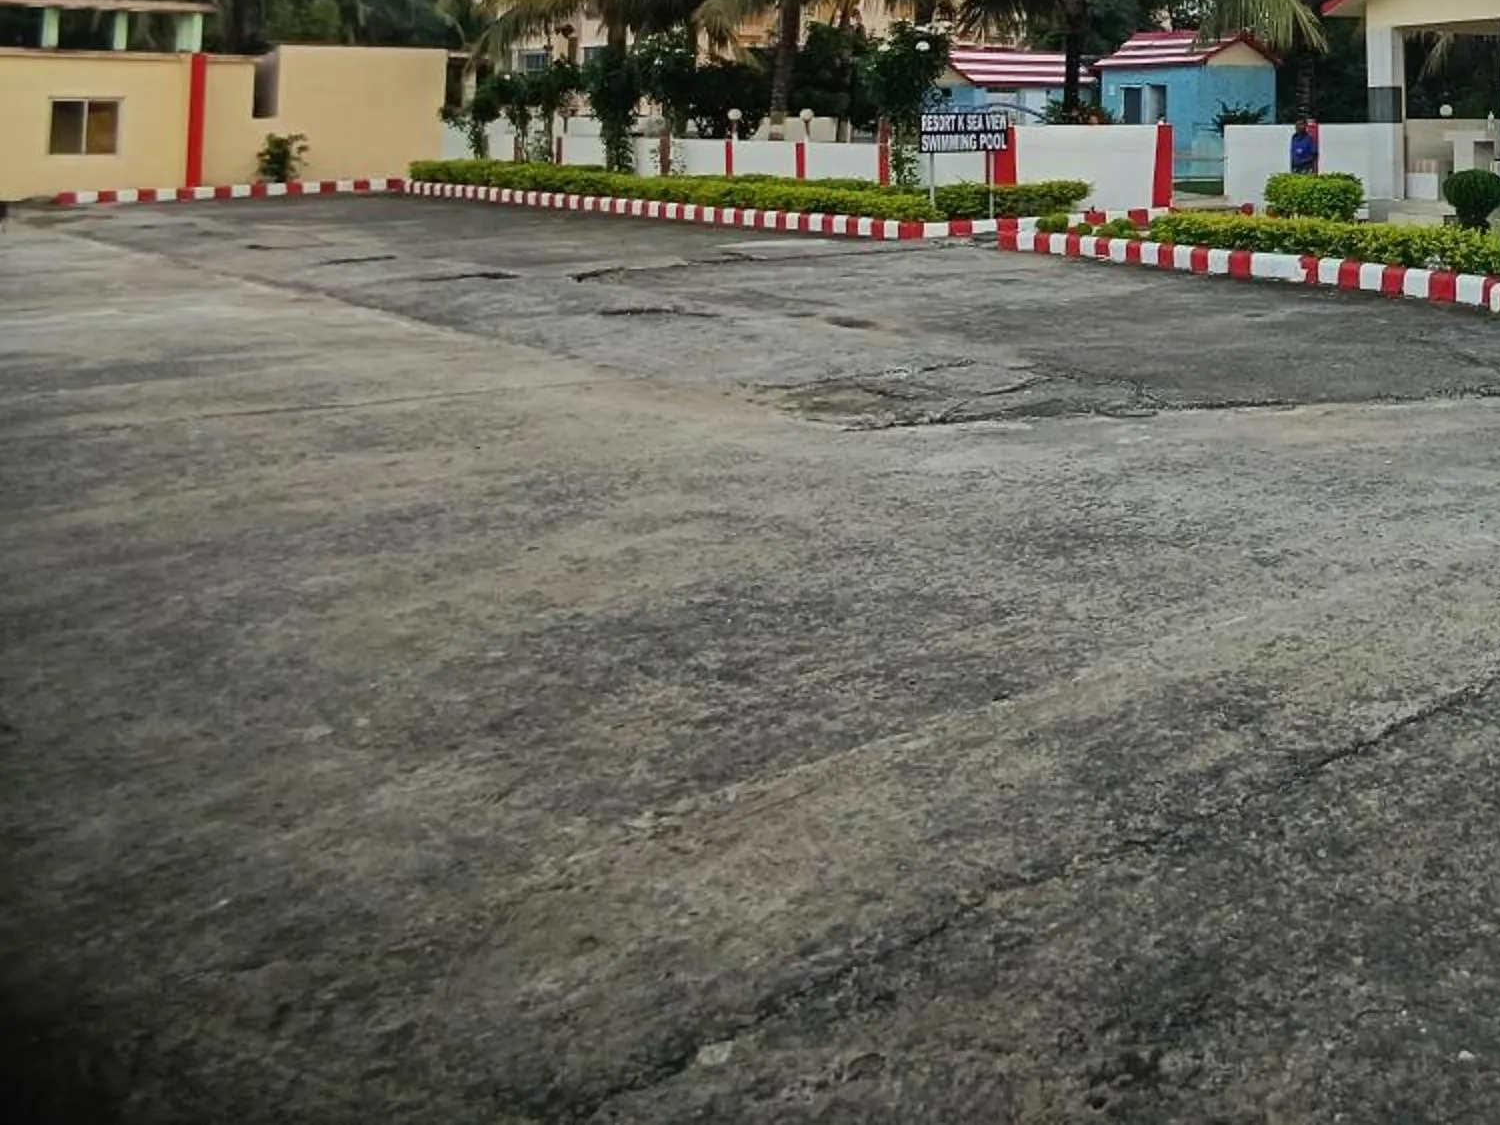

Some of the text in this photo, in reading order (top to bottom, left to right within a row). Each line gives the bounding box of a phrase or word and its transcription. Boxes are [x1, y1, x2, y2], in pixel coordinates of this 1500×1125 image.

[921, 114, 956, 132] RESORT
[957, 114, 965, 131] K
[966, 114, 984, 131] SEA
[921, 133, 1007, 152] SWIMMING POOL
